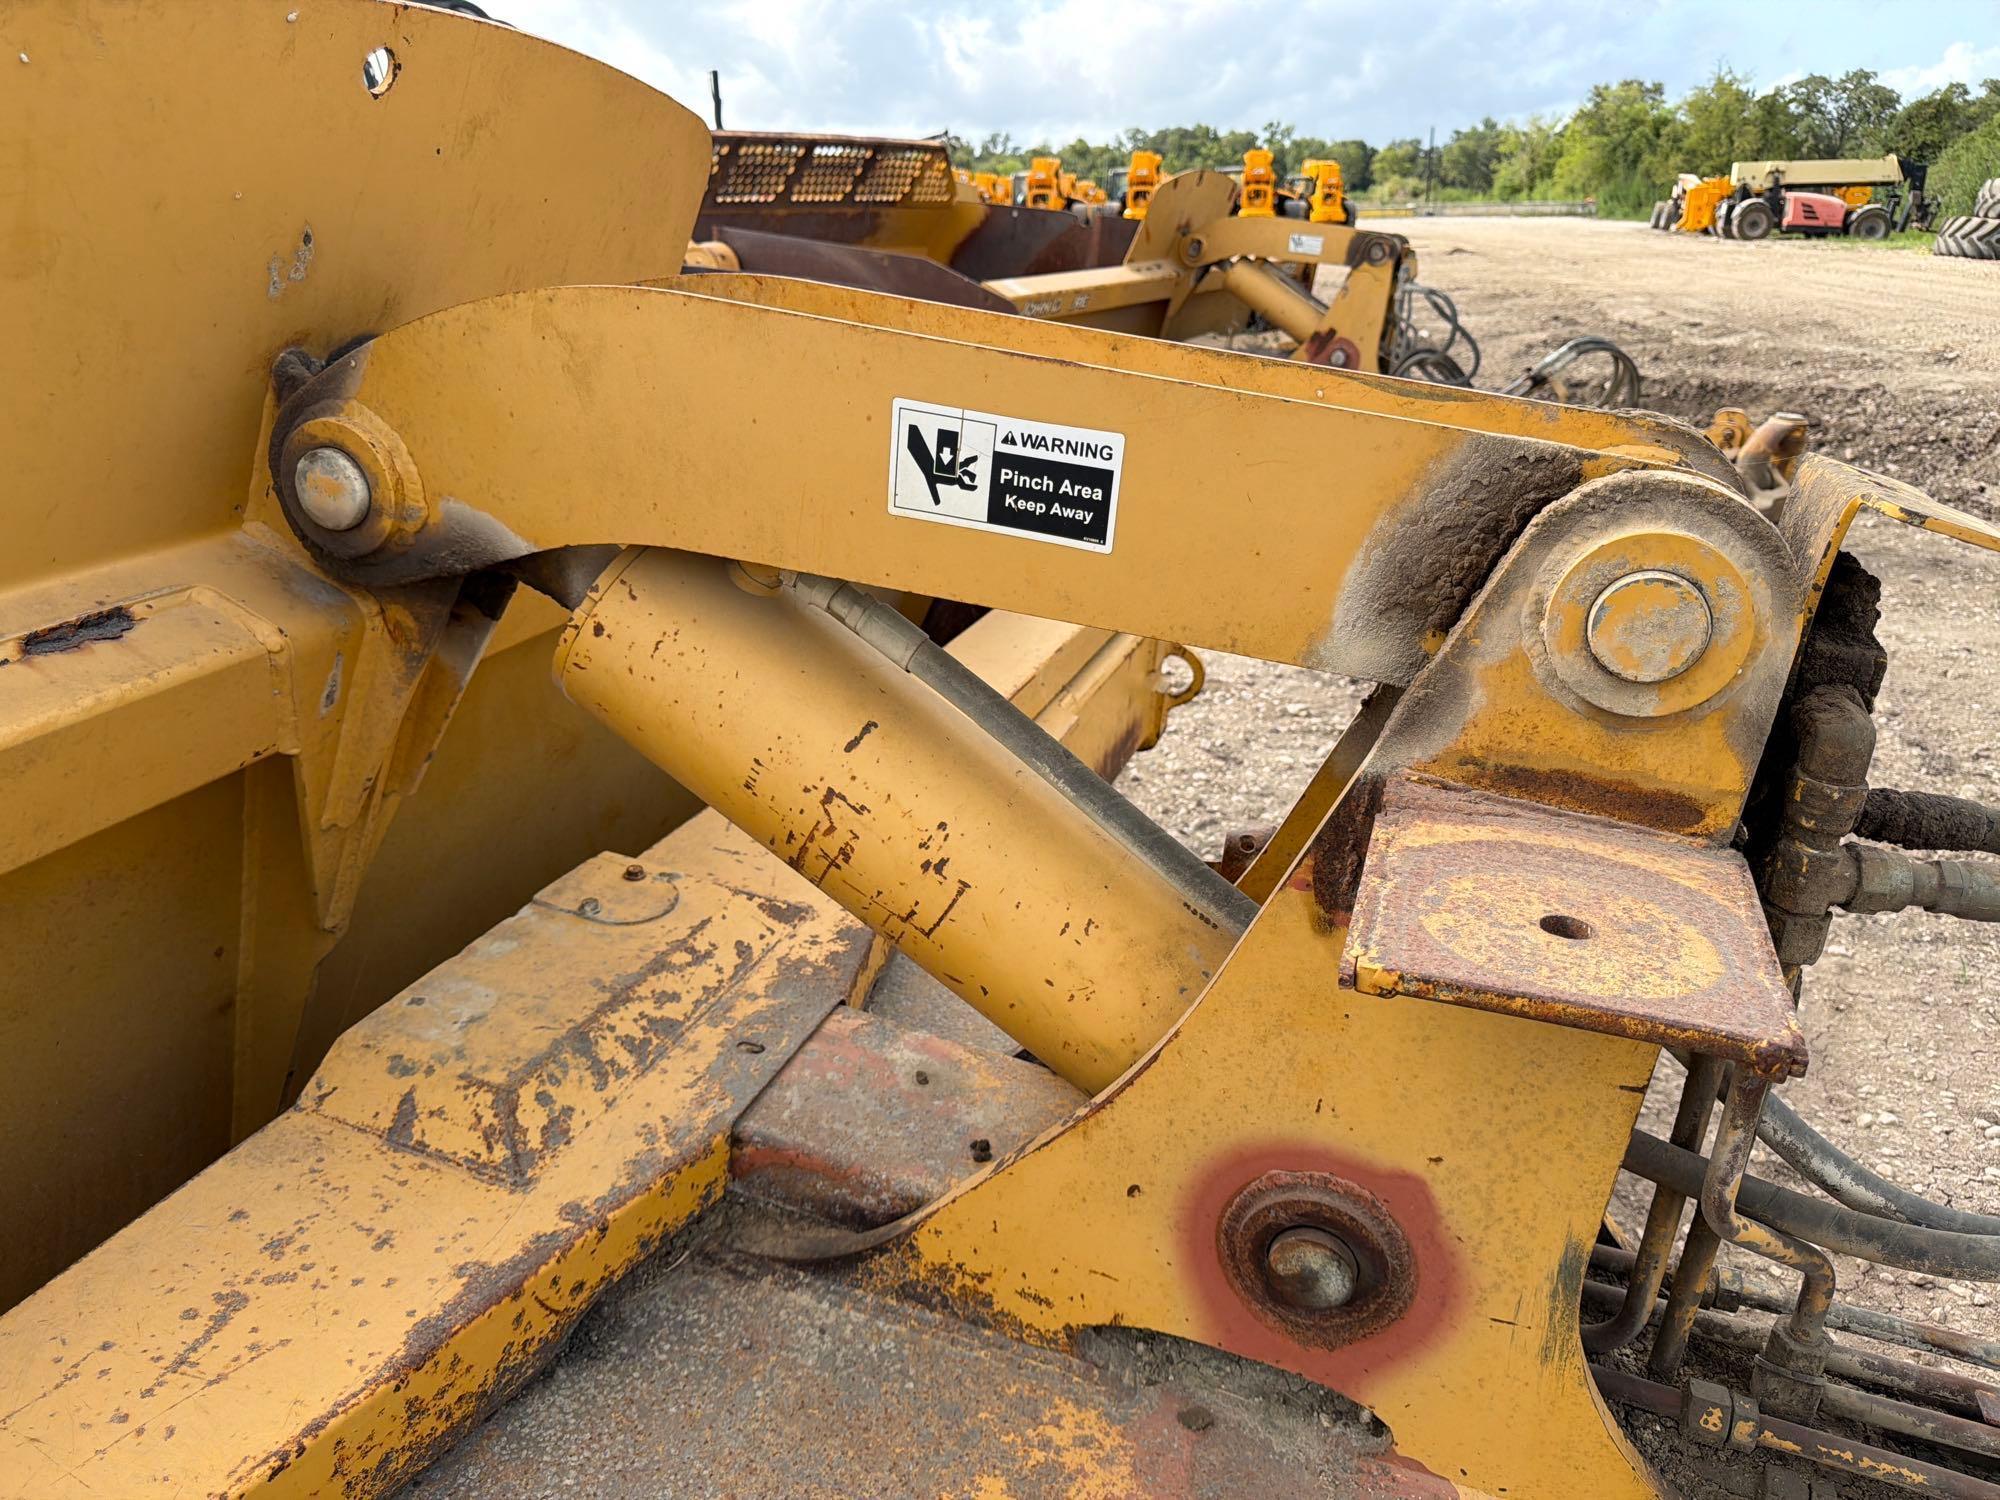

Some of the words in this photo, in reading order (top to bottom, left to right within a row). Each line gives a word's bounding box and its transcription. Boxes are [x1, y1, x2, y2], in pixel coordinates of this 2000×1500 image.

[1020, 432, 1114, 461] WARNING
[1000, 468, 1054, 493] Pinch
[1058, 479, 1103, 501] Area
[1005, 493, 1046, 516] Keep
[1050, 502, 1094, 525] Away
